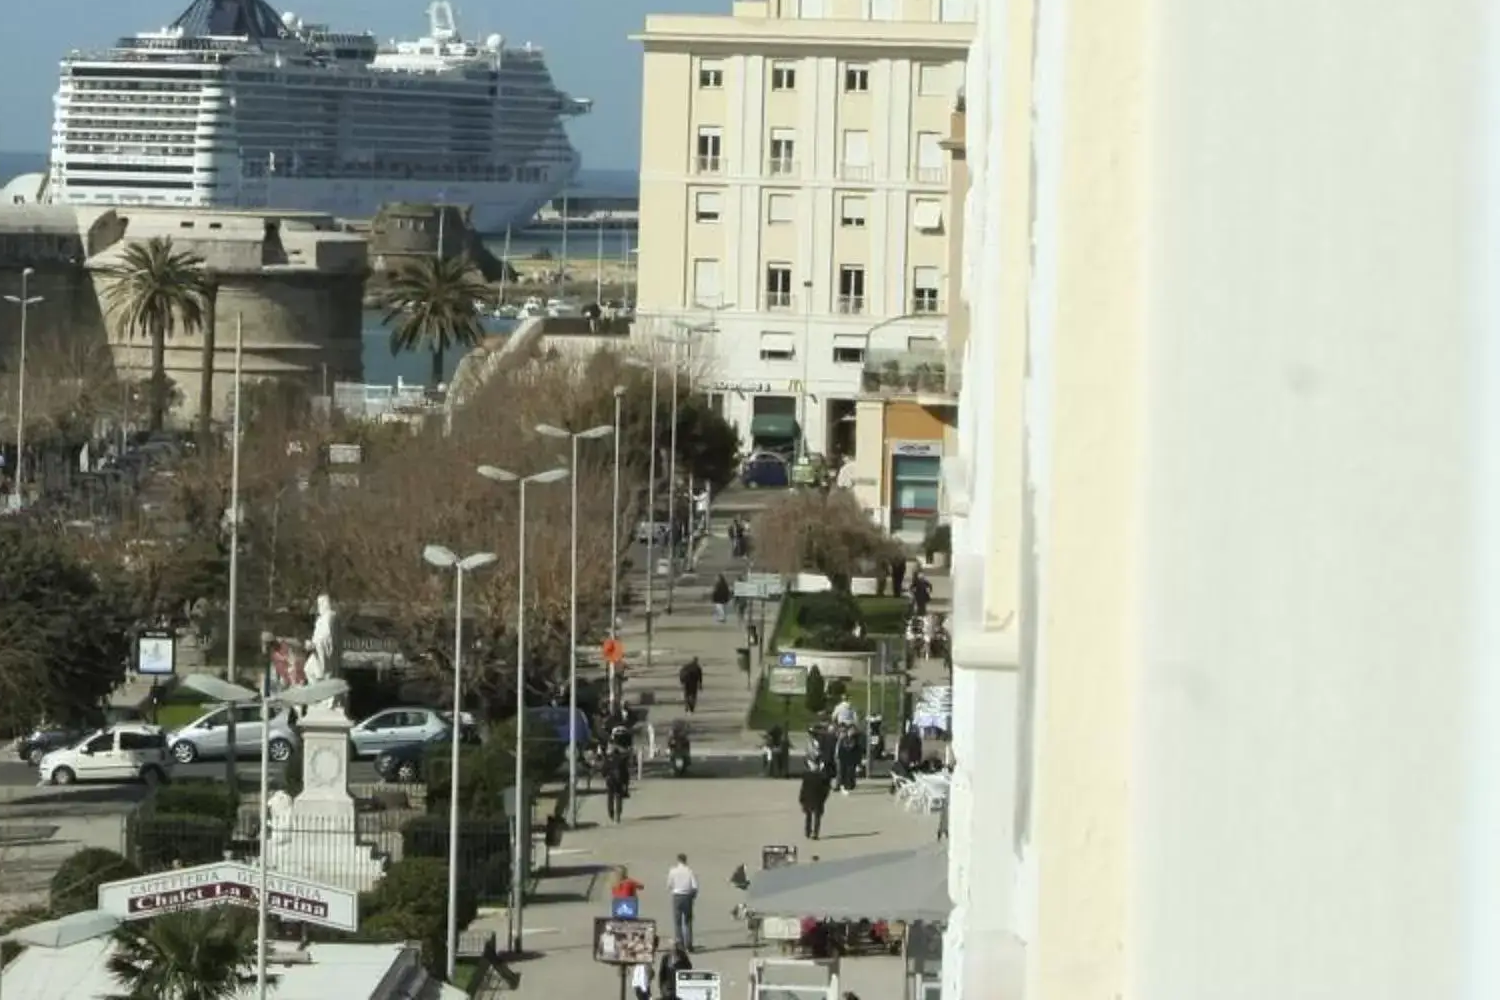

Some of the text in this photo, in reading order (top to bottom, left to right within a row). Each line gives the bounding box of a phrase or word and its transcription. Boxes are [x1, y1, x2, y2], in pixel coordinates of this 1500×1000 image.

[136, 888, 204, 910] Chalet
[215, 884, 241, 897] La
[237, 871, 322, 898] GEATERIA
